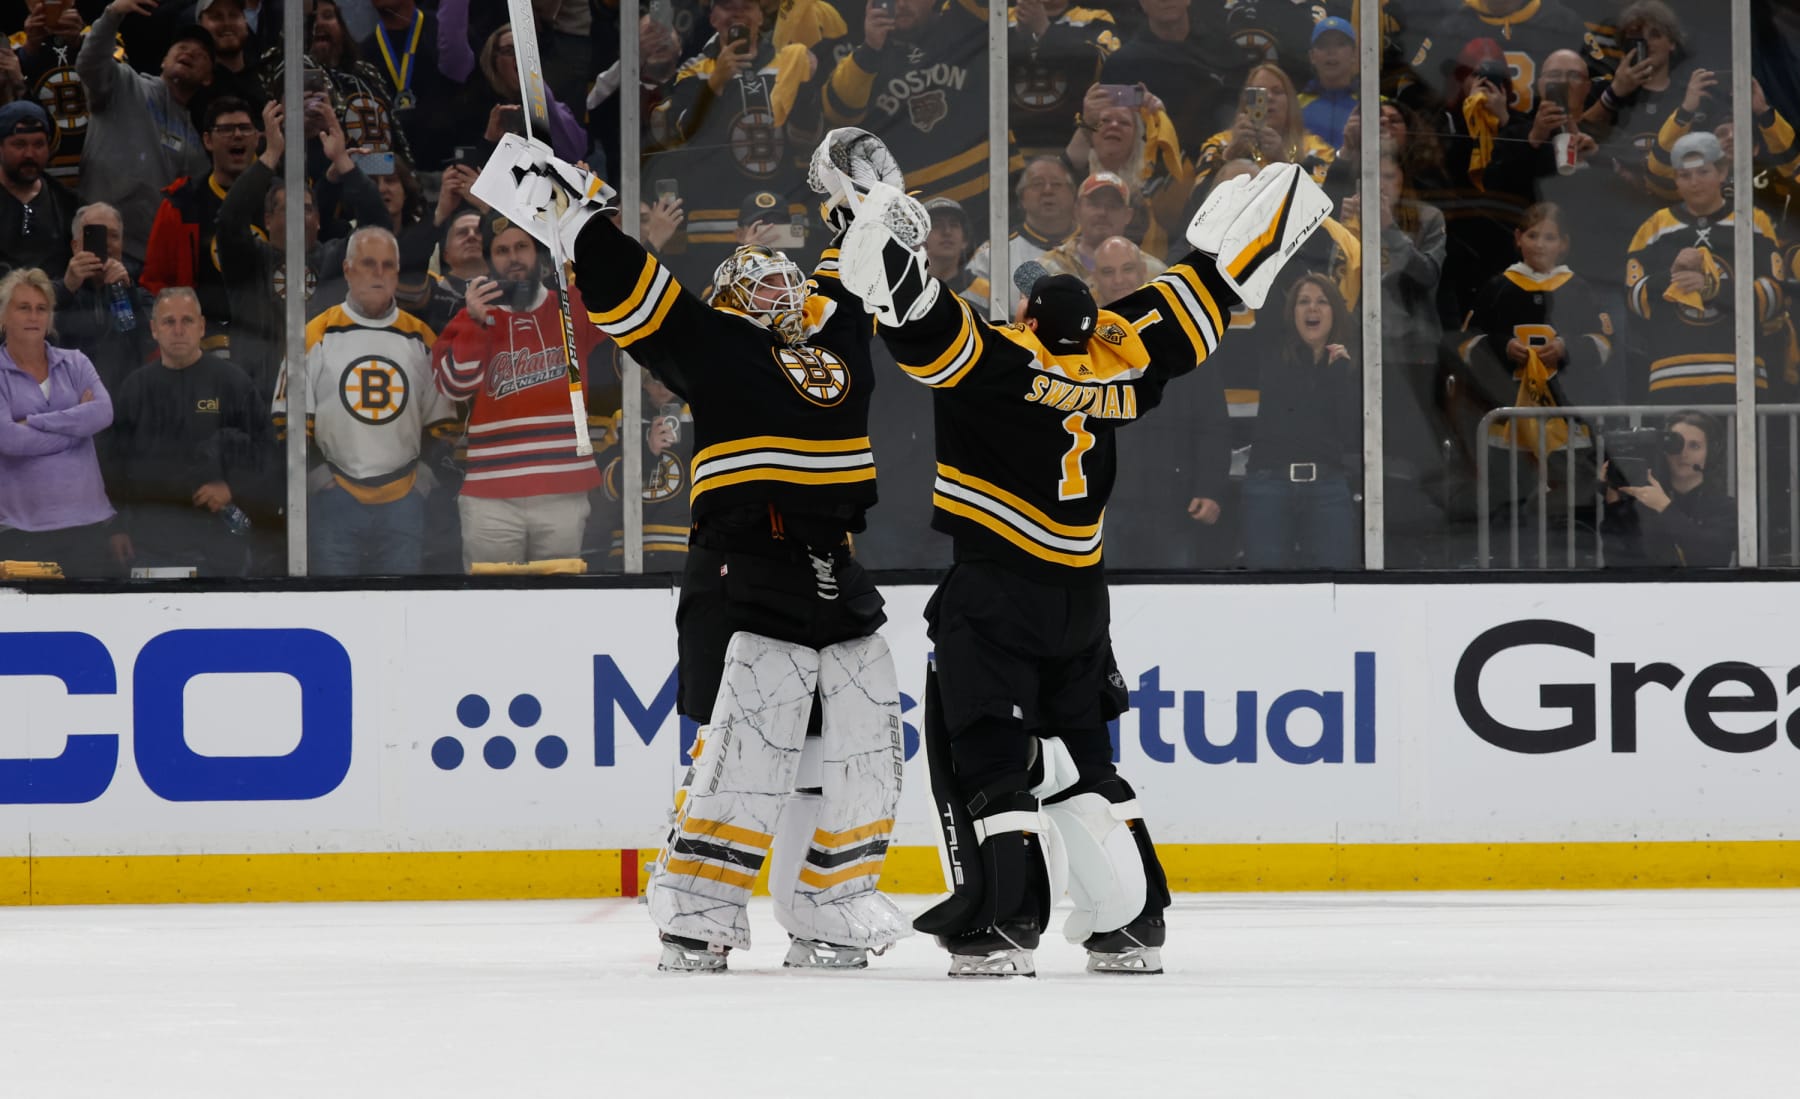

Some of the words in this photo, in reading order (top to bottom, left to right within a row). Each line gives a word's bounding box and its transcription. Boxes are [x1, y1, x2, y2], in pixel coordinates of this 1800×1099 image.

[875, 63, 967, 116] BOSTON
[197, 398, 219, 411] cal
[360, 369, 391, 410] B
[1024, 375, 1137, 419] SWAYMAN
[1058, 410, 1096, 501] 1
[0, 628, 352, 804] CO
[1453, 618, 1800, 754] Gre
[943, 802, 964, 885] TRUE
